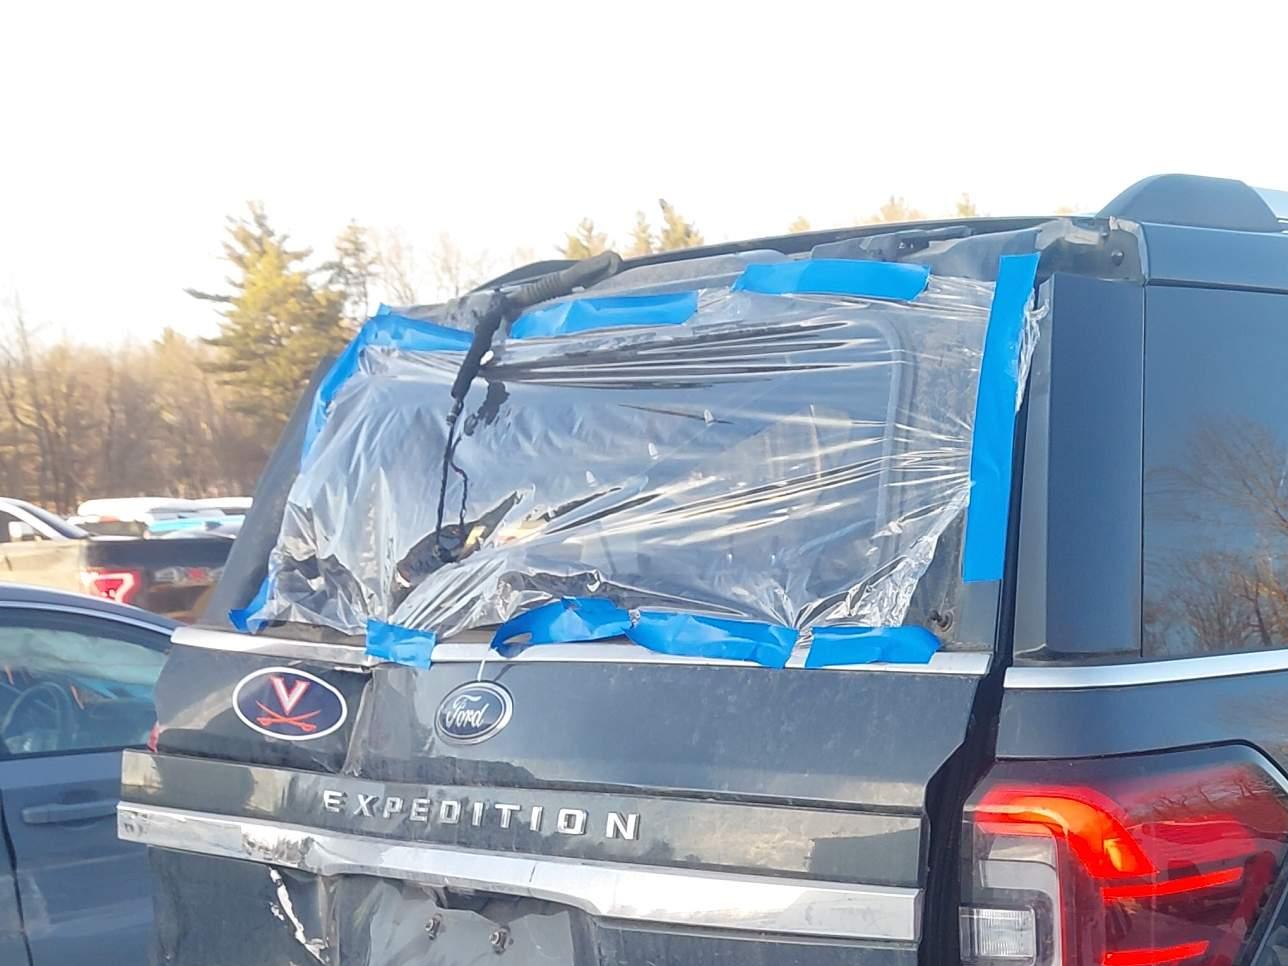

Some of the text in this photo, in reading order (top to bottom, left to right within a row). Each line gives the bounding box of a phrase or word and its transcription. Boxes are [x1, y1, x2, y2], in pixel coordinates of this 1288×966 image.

[269, 673, 311, 716] V
[445, 694, 490, 729] Ford
[322, 790, 641, 840] EXPEDITION
